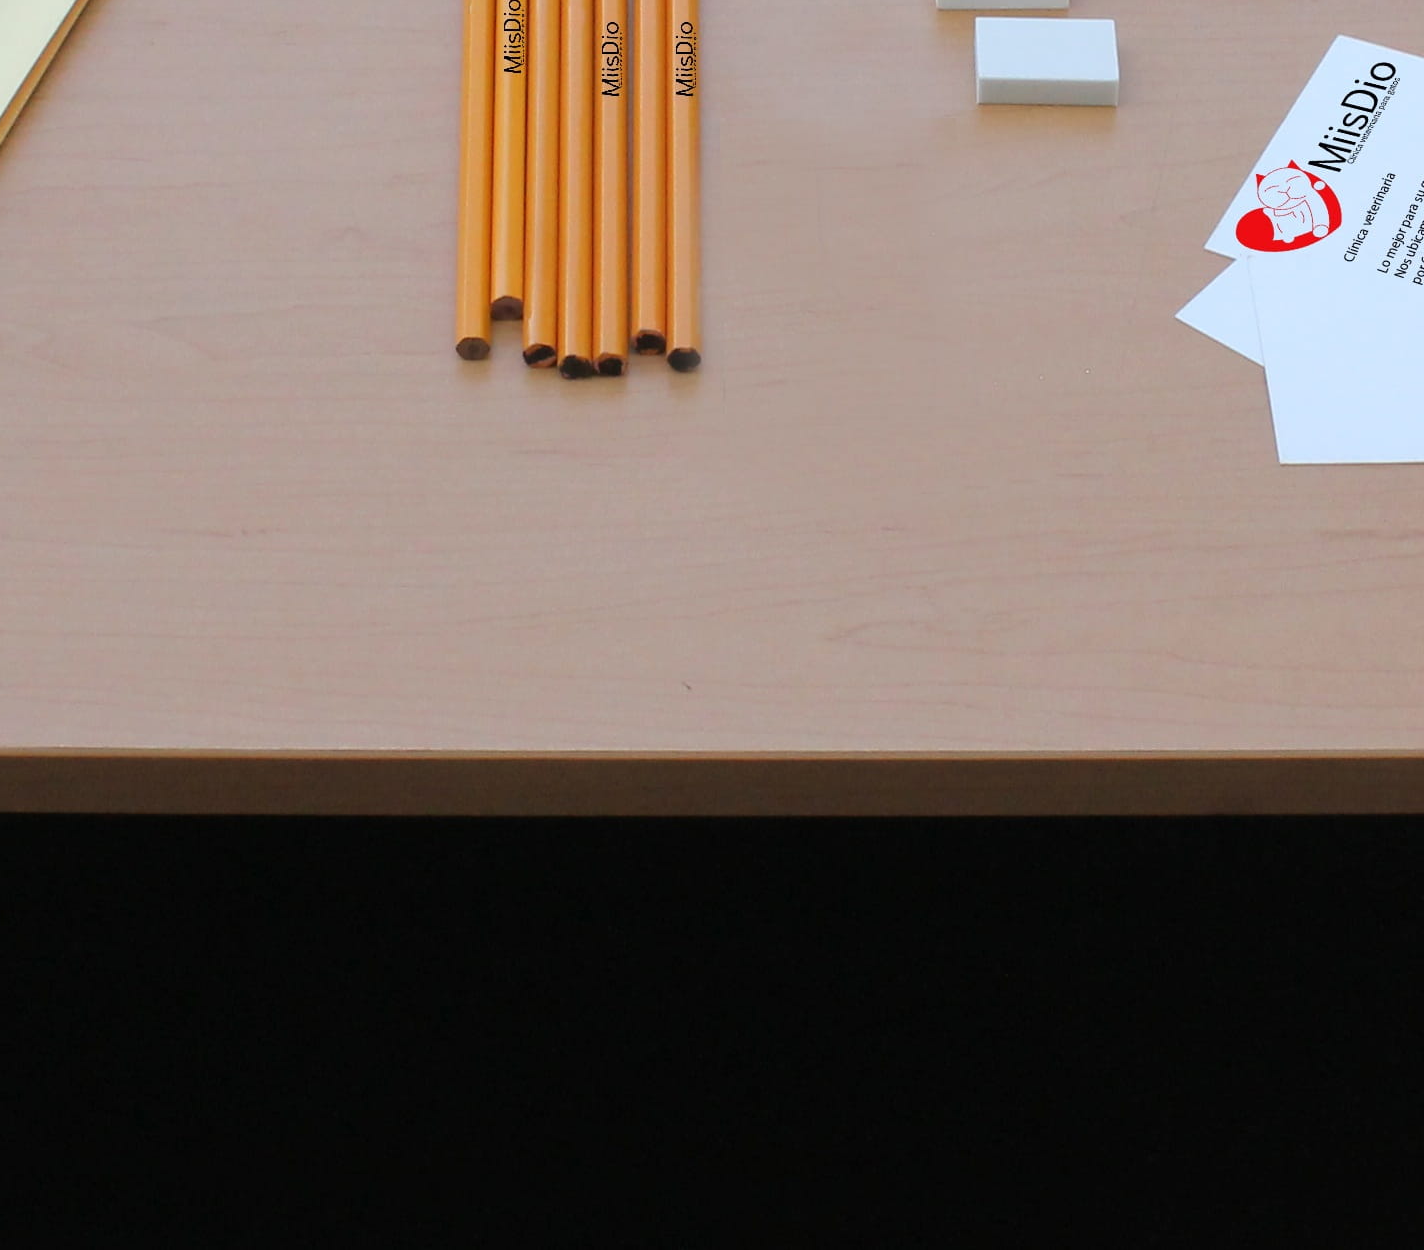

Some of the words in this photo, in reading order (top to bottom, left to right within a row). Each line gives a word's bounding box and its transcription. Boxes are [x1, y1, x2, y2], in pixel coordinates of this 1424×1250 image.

[602, 21, 620, 97] MiisDio
[675, 21, 694, 97] MiisDio
[1307, 61, 1397, 173] MiisDio
[1343, 227, 1369, 263] Clínica
[1363, 172, 1397, 226] veterinaria
[1377, 259, 1391, 274] Lo
[1386, 227, 1407, 259] mejor
[1402, 203, 1419, 229] para
[1393, 258, 1412, 279] Nos
